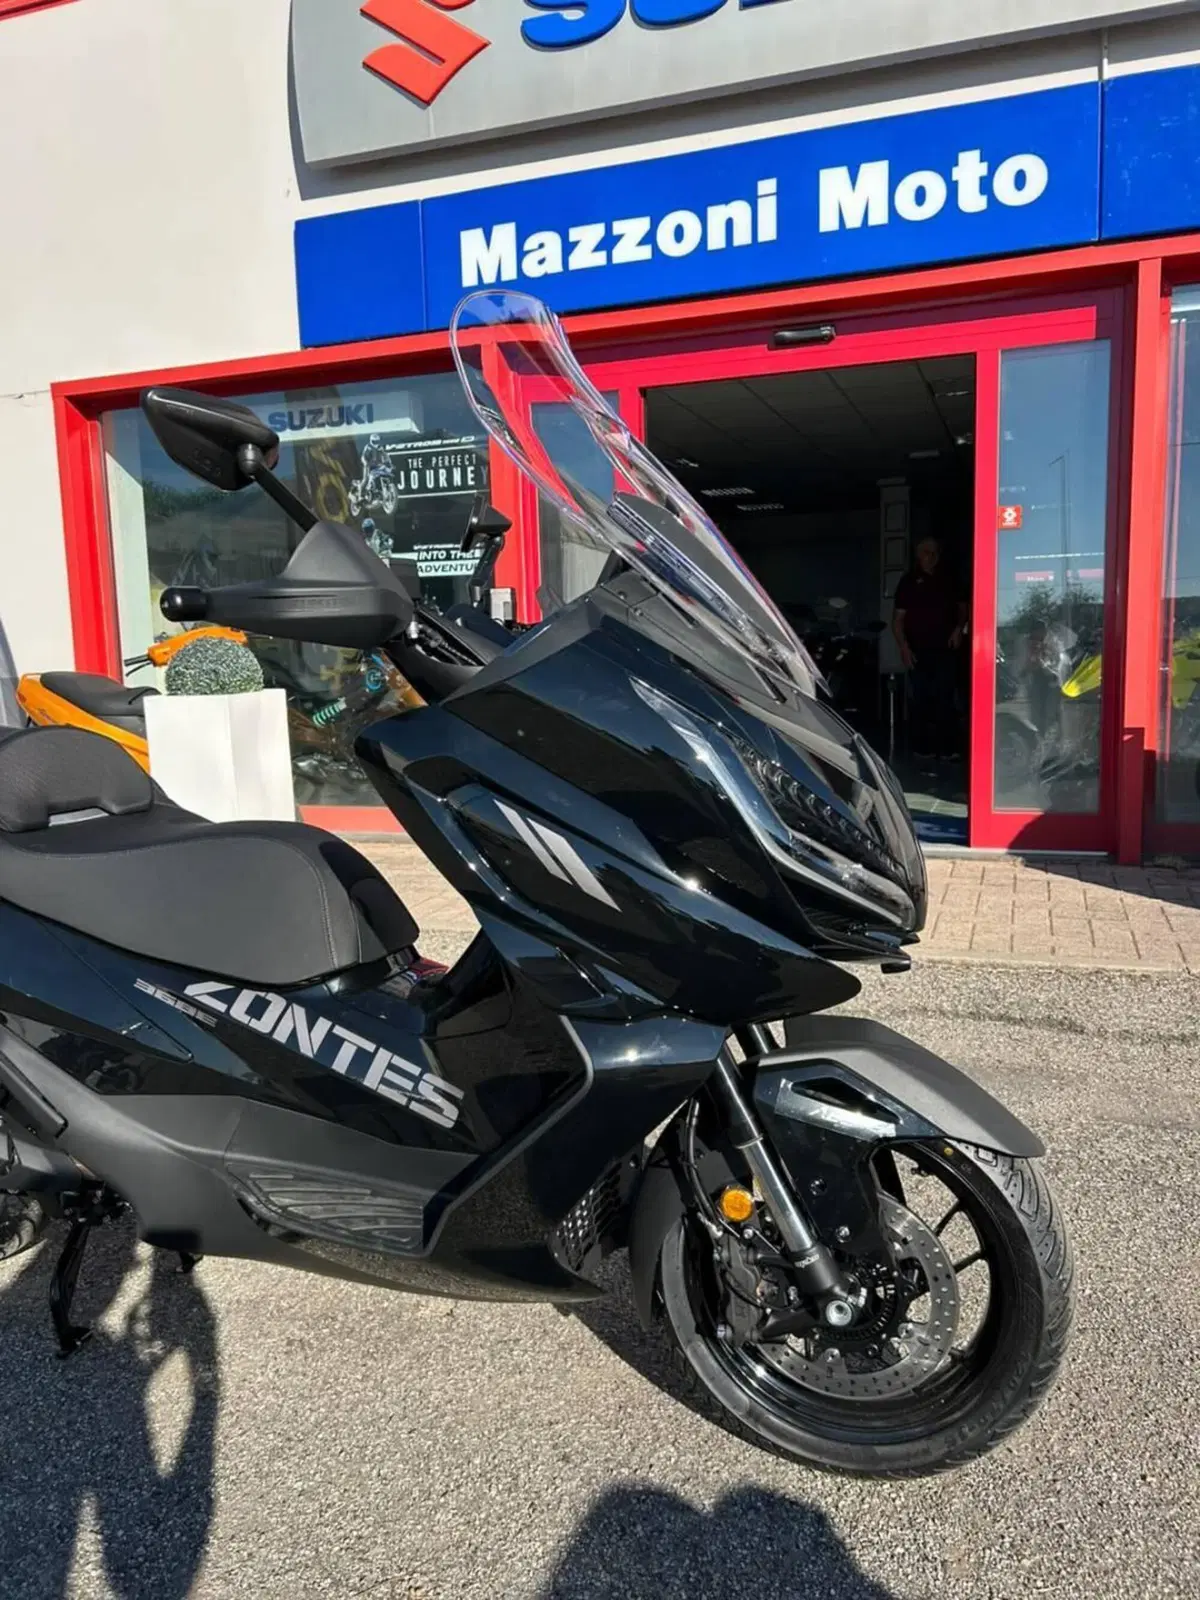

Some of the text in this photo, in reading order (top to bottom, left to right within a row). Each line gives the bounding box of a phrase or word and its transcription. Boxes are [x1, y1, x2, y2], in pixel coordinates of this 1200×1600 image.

[460, 148, 1049, 288] Mazzoni Moto
[268, 403, 374, 432] SUZUKI
[408, 453, 477, 469] THE PERFECT
[419, 550, 447, 561] INTO
[417, 562, 476, 574] ADVENTU
[183, 981, 465, 1129] ZONTES
